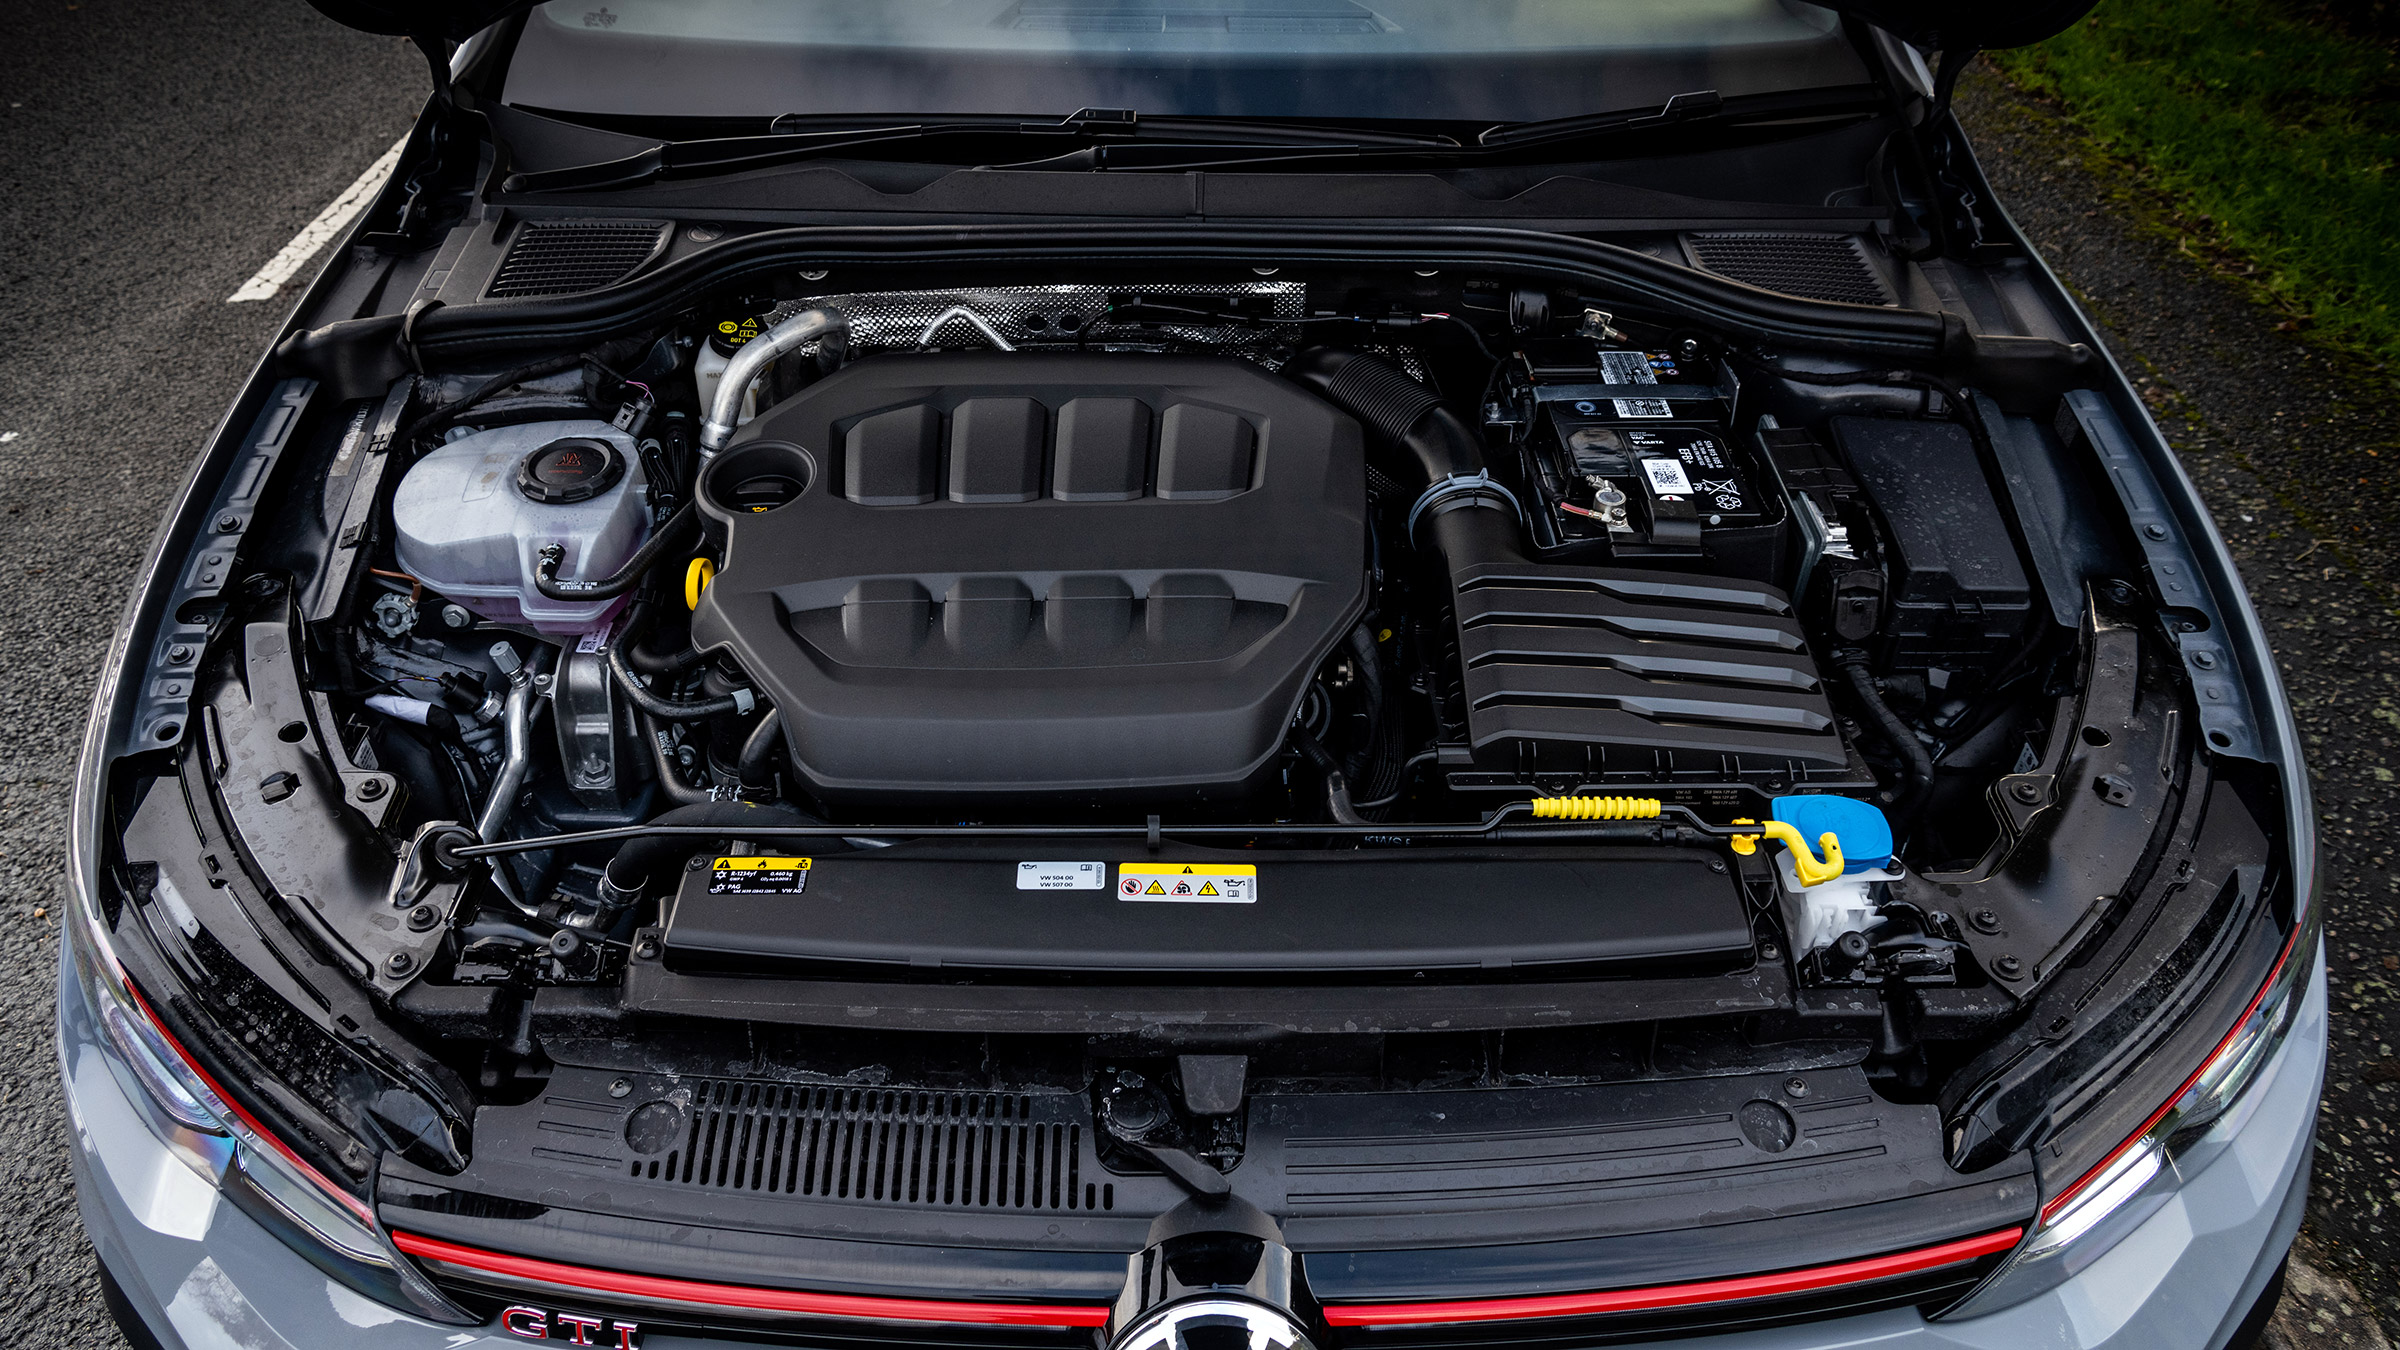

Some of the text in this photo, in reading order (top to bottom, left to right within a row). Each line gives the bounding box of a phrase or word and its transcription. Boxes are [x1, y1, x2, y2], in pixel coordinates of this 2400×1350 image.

[1678, 448, 1694, 464] EFB+
[1692, 483, 1704, 491] Pb
[502, 1305, 639, 1350] GTI
